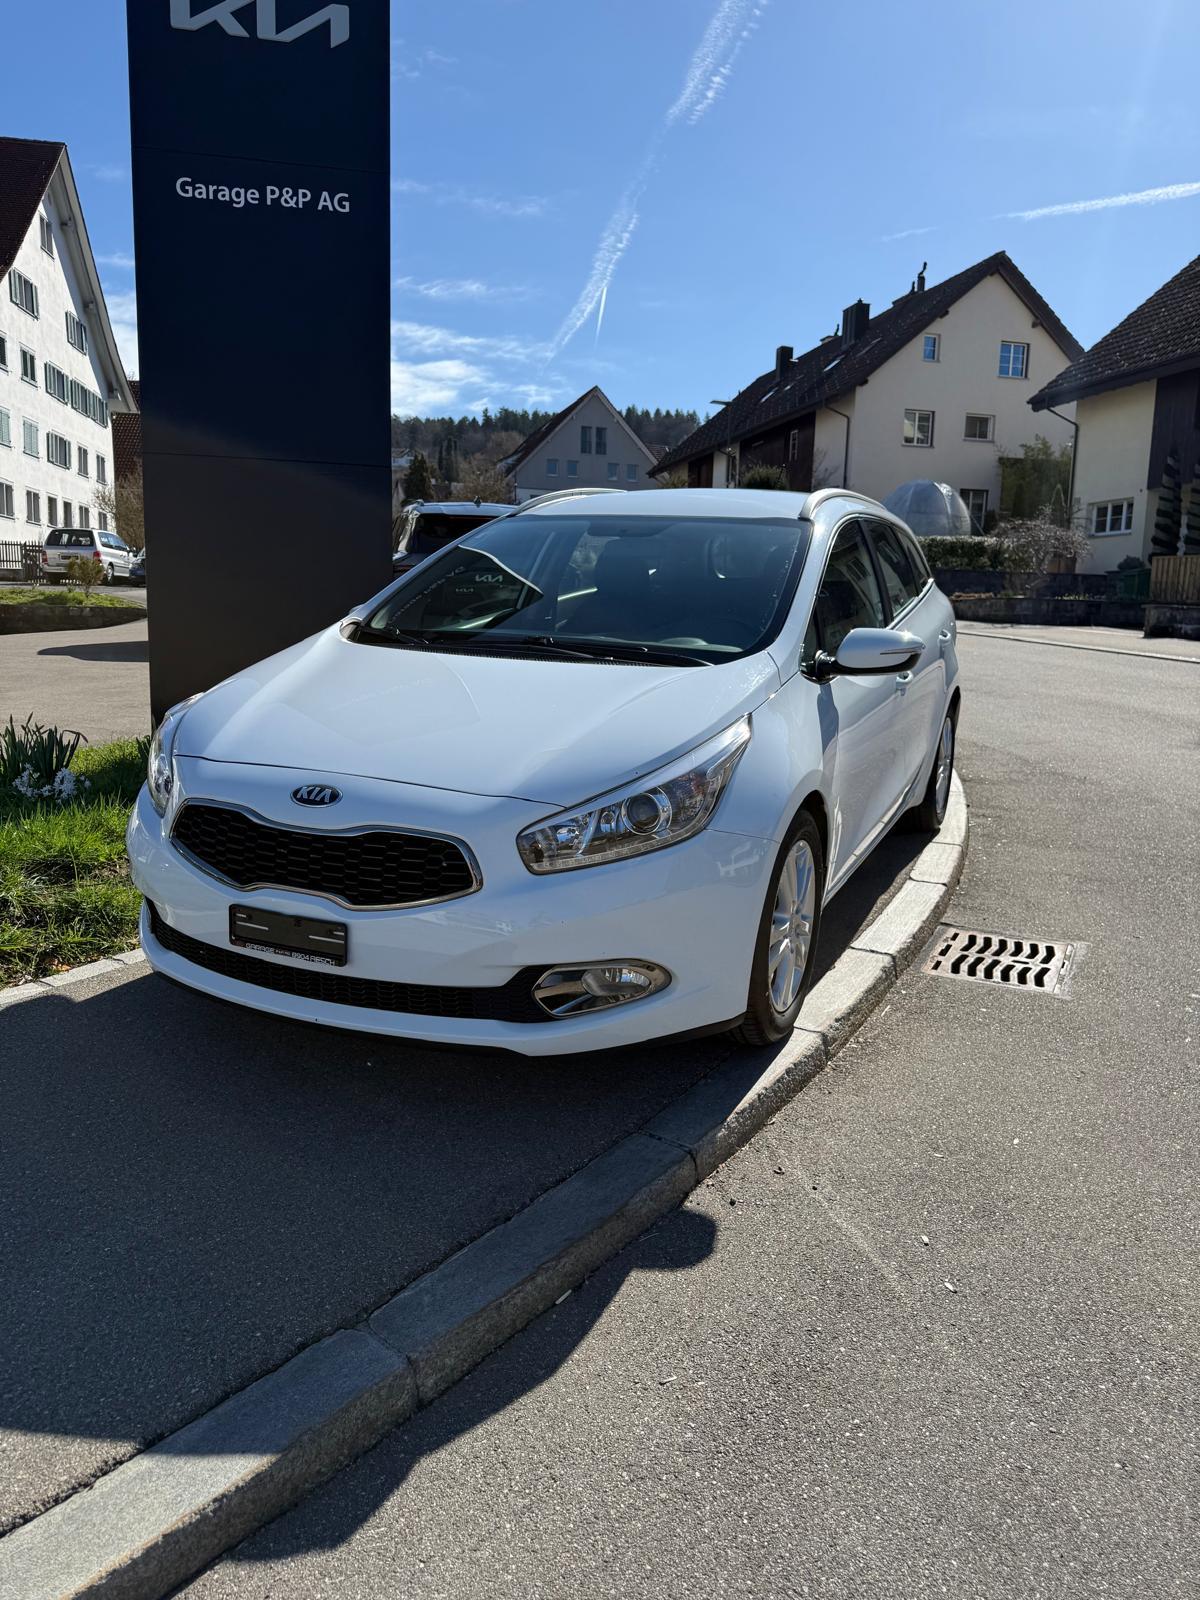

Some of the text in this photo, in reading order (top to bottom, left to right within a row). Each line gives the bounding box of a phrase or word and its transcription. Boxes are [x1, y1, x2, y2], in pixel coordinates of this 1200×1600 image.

[175, 176, 350, 213] Garage P&P AG
[296, 786, 332, 803] KIA
